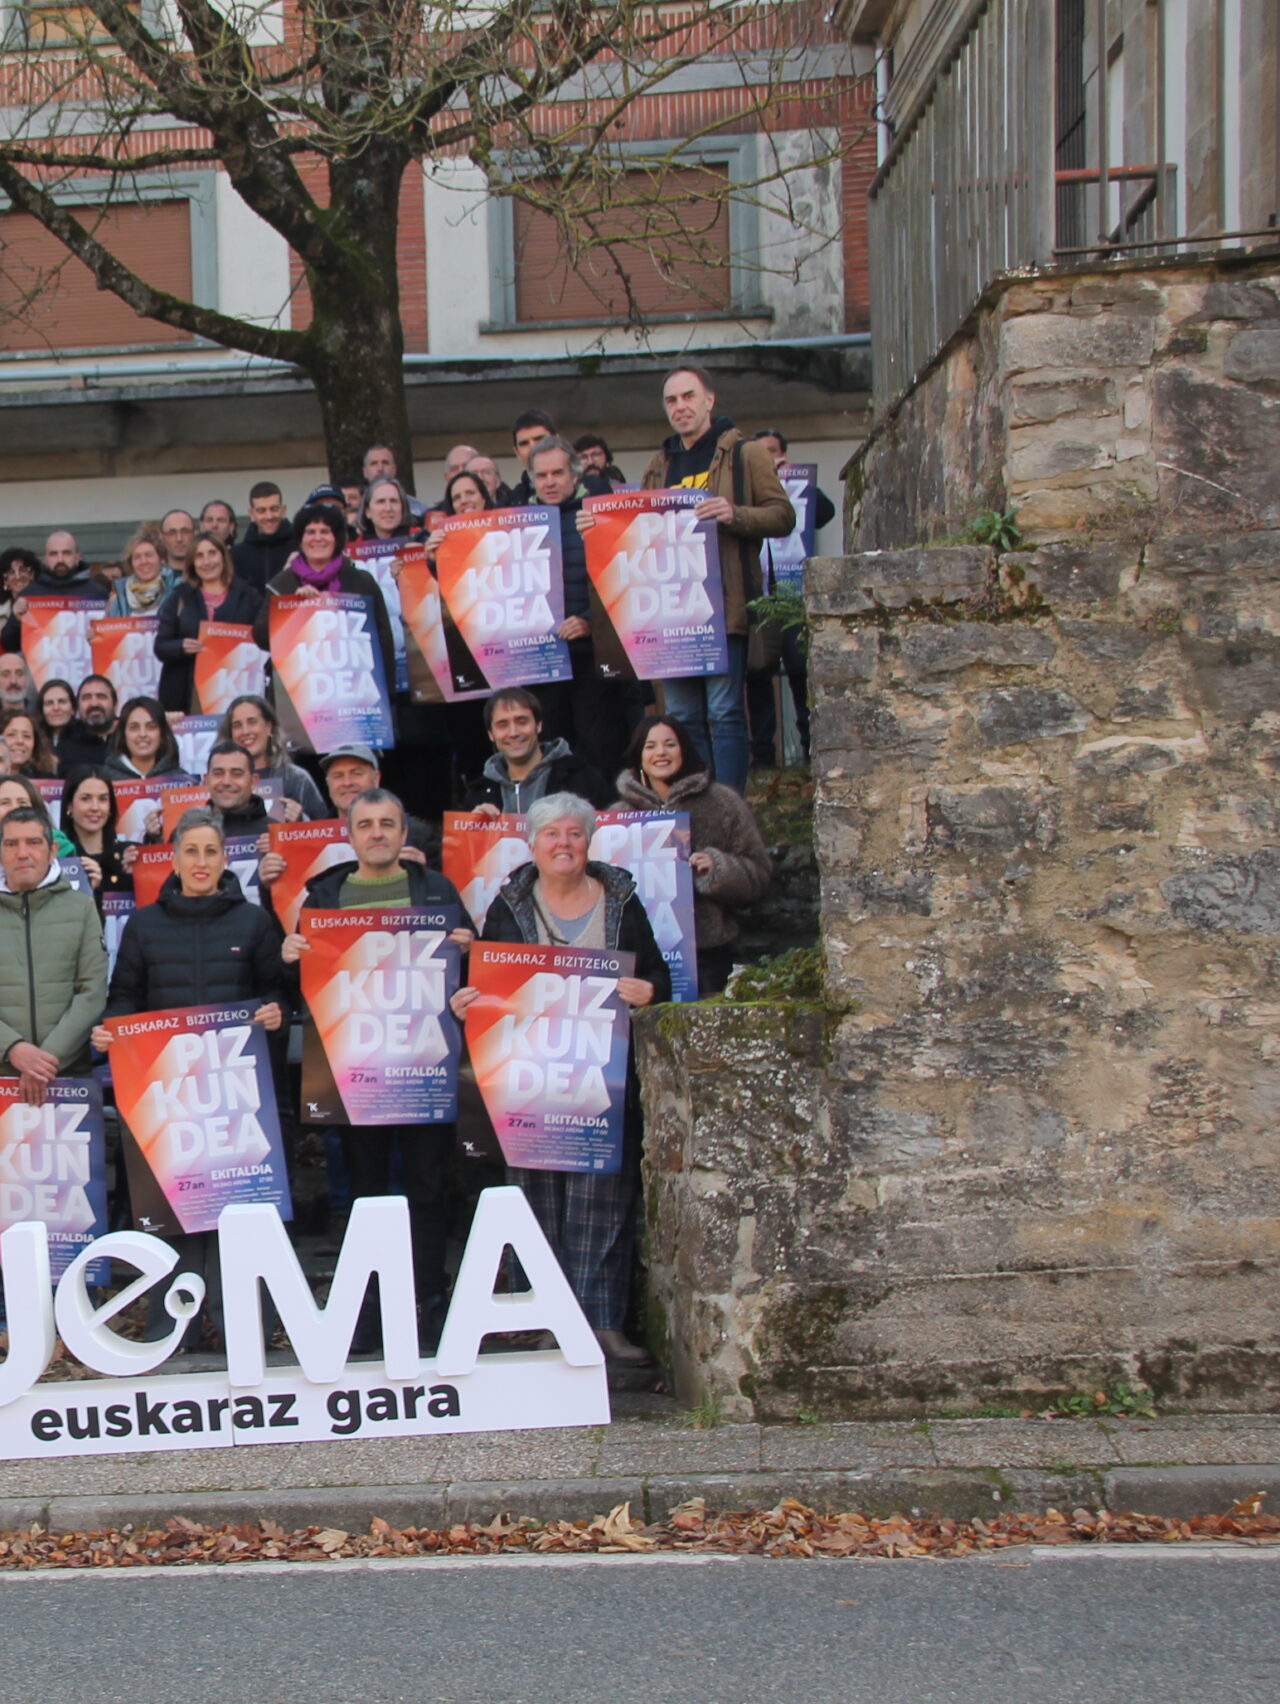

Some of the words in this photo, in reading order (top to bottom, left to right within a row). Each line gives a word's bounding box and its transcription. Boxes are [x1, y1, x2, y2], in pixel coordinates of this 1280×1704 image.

[592, 500, 644, 513] EUSKARAZ
[651, 495, 704, 507] BIZITZEKO
[444, 518, 492, 532] EUSKARAZ
[498, 512, 548, 525] BIZITZEKO
[637, 510, 706, 545] PIZ
[485, 526, 550, 563] PIZ
[466, 558, 550, 601] KUN
[617, 545, 707, 585] KUN
[478, 595, 555, 631] DEA
[629, 582, 714, 620] DEA
[316, 611, 370, 639] PIZ
[508, 635, 555, 648] EKITALDIA
[663, 625, 714, 637] EKITALDIA
[298, 640, 375, 674] KUN
[309, 671, 381, 706] DEA
[170, 791, 211, 804] EUSKARA
[278, 828, 334, 841] EUSKARAZ
[454, 820, 509, 832] EUSKARAZ
[600, 820, 677, 861] PIZ
[310, 916, 373, 928] EUSKARAZ
[381, 915, 446, 926] BIZITZEKO
[364, 931, 447, 969] PIZ
[483, 951, 546, 965] EUSKARAZ
[554, 956, 619, 971] BIZITZEKO
[338, 969, 446, 1014] KUN
[534, 972, 619, 1019] PIZ
[118, 1018, 179, 1036] EUSKARAZ
[187, 1010, 249, 1026] BIZITZEKO
[348, 1014, 449, 1054] DEA
[501, 1014, 613, 1064] KUN
[174, 1025, 256, 1073] PIZ
[385, 1067, 447, 1077] EKITALDIA
[508, 1060, 612, 1107] DEA
[152, 1069, 261, 1118] KUN
[10, 1103, 91, 1143] PIZ
[169, 1113, 271, 1161] DEA
[544, 1114, 609, 1128] EKITALDIA
[211, 1164, 273, 1181] EKITALDIA
[47, 1232, 96, 1243] KITALDIA
[30, 1392, 299, 1442] euskaraz
[326, 1383, 462, 1434] gara
